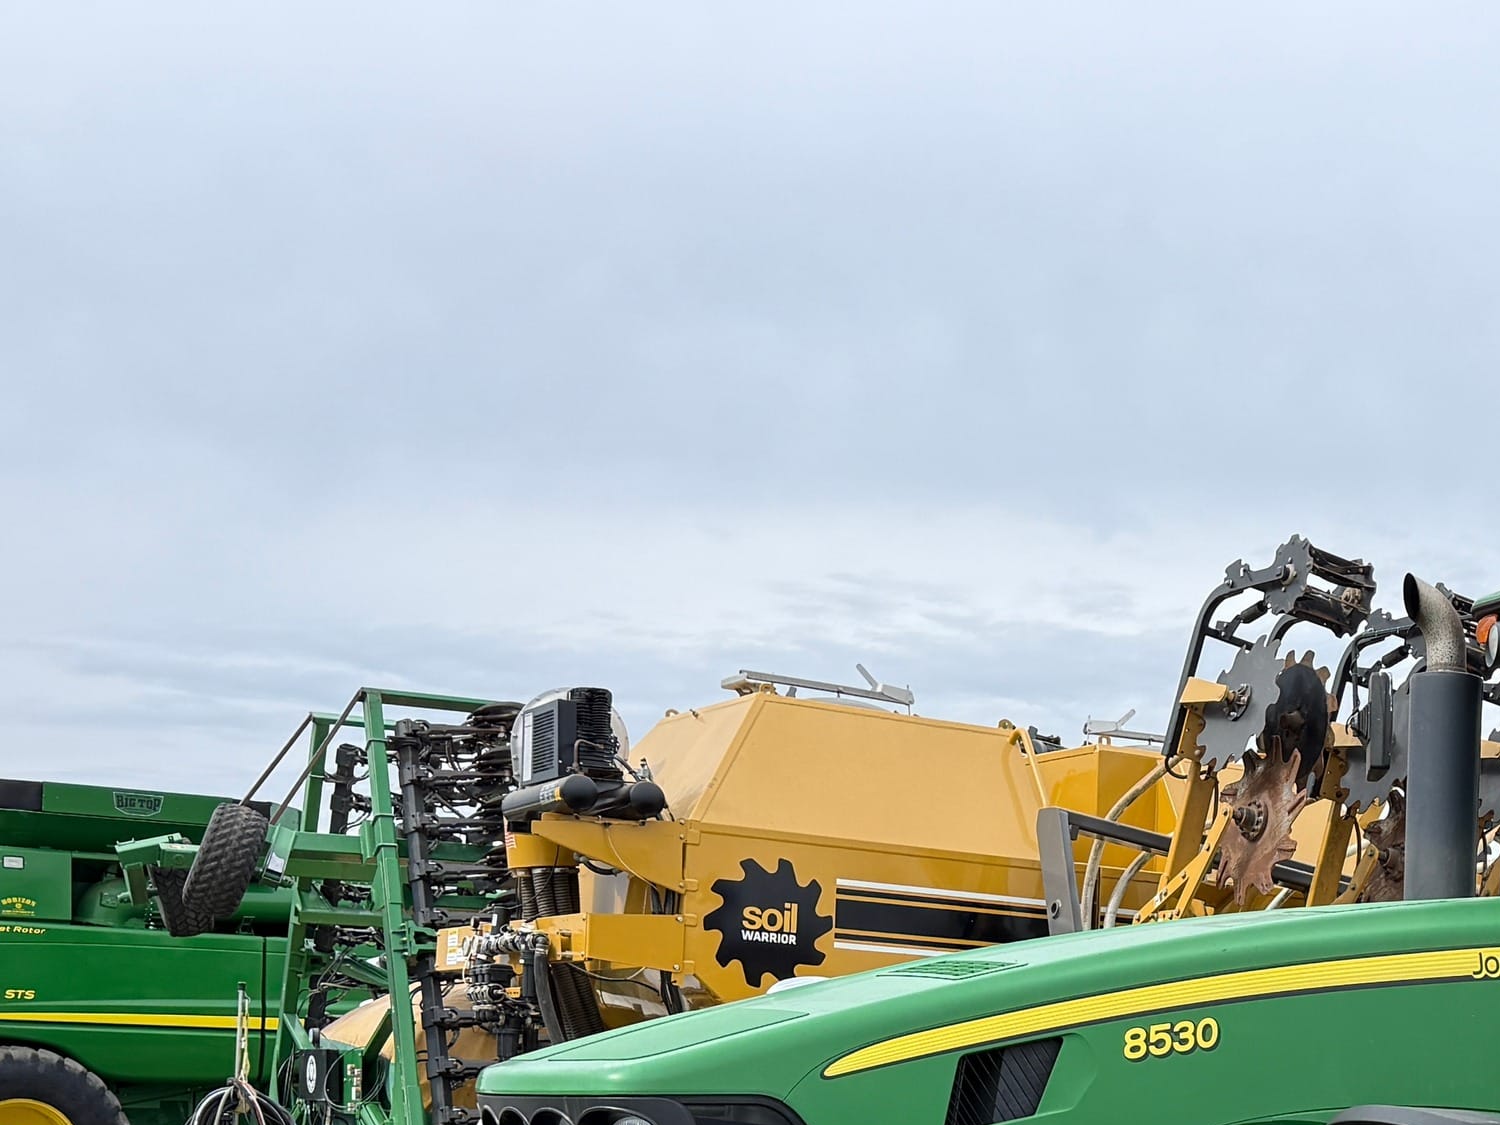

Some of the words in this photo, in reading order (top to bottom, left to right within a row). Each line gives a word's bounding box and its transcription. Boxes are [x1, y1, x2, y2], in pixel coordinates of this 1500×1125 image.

[116, 796, 137, 808] BIG
[137, 798, 161, 811] TOP
[742, 902, 799, 934] soil
[13, 926, 46, 934] Rotor
[741, 929, 797, 946] WARRIOR
[4, 989, 36, 1000] STS
[1123, 1017, 1219, 1061] 8530
